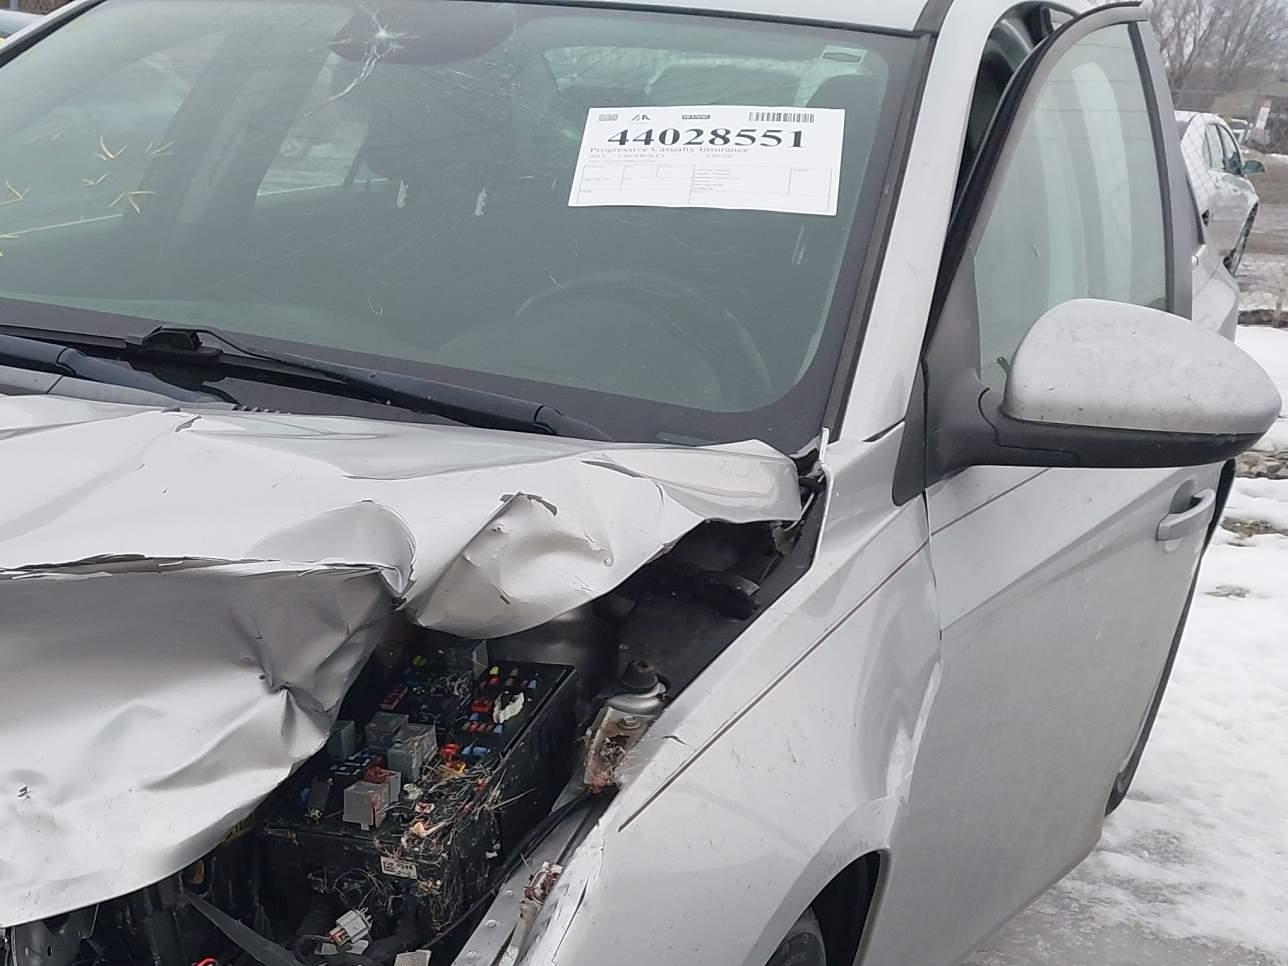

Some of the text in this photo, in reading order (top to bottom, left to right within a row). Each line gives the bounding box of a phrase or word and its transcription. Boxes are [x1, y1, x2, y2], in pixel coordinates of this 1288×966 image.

[608, 128, 806, 148] 44028551
[590, 146, 749, 155] Progressive Casualty Insurance
